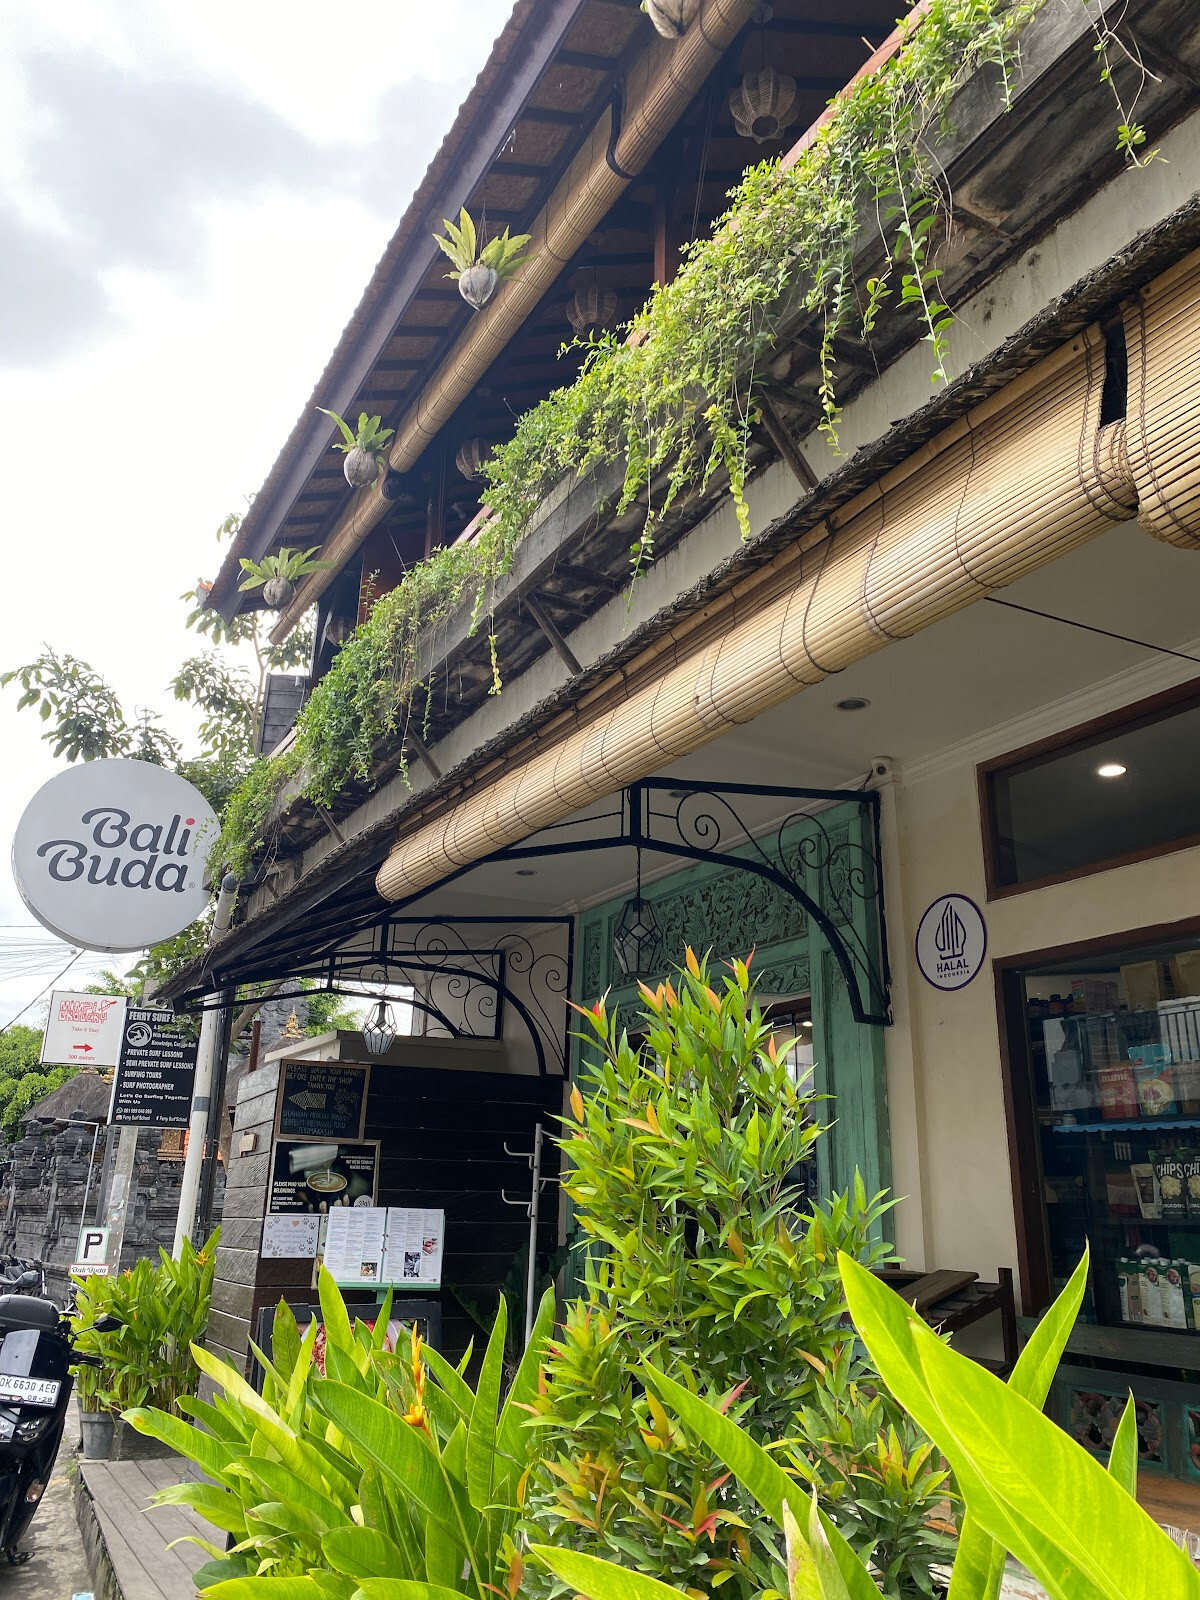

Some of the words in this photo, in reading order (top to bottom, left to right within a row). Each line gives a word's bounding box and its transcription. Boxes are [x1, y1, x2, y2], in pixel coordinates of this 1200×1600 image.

[82, 808, 195, 856] Bali
[37, 840, 188, 892] Buda
[937, 959, 968, 973] HALAL
[937, 970, 970, 979] INDONESIA
[129, 1012, 151, 1021] FERRY
[152, 1013, 171, 1022] SURF
[1157, 1163, 1184, 1178] CHIPS
[84, 1233, 103, 1258] P
[0, 1378, 12, 1388] DK
[14, 1380, 36, 1390] 6630
[39, 1383, 56, 1393] AEB
